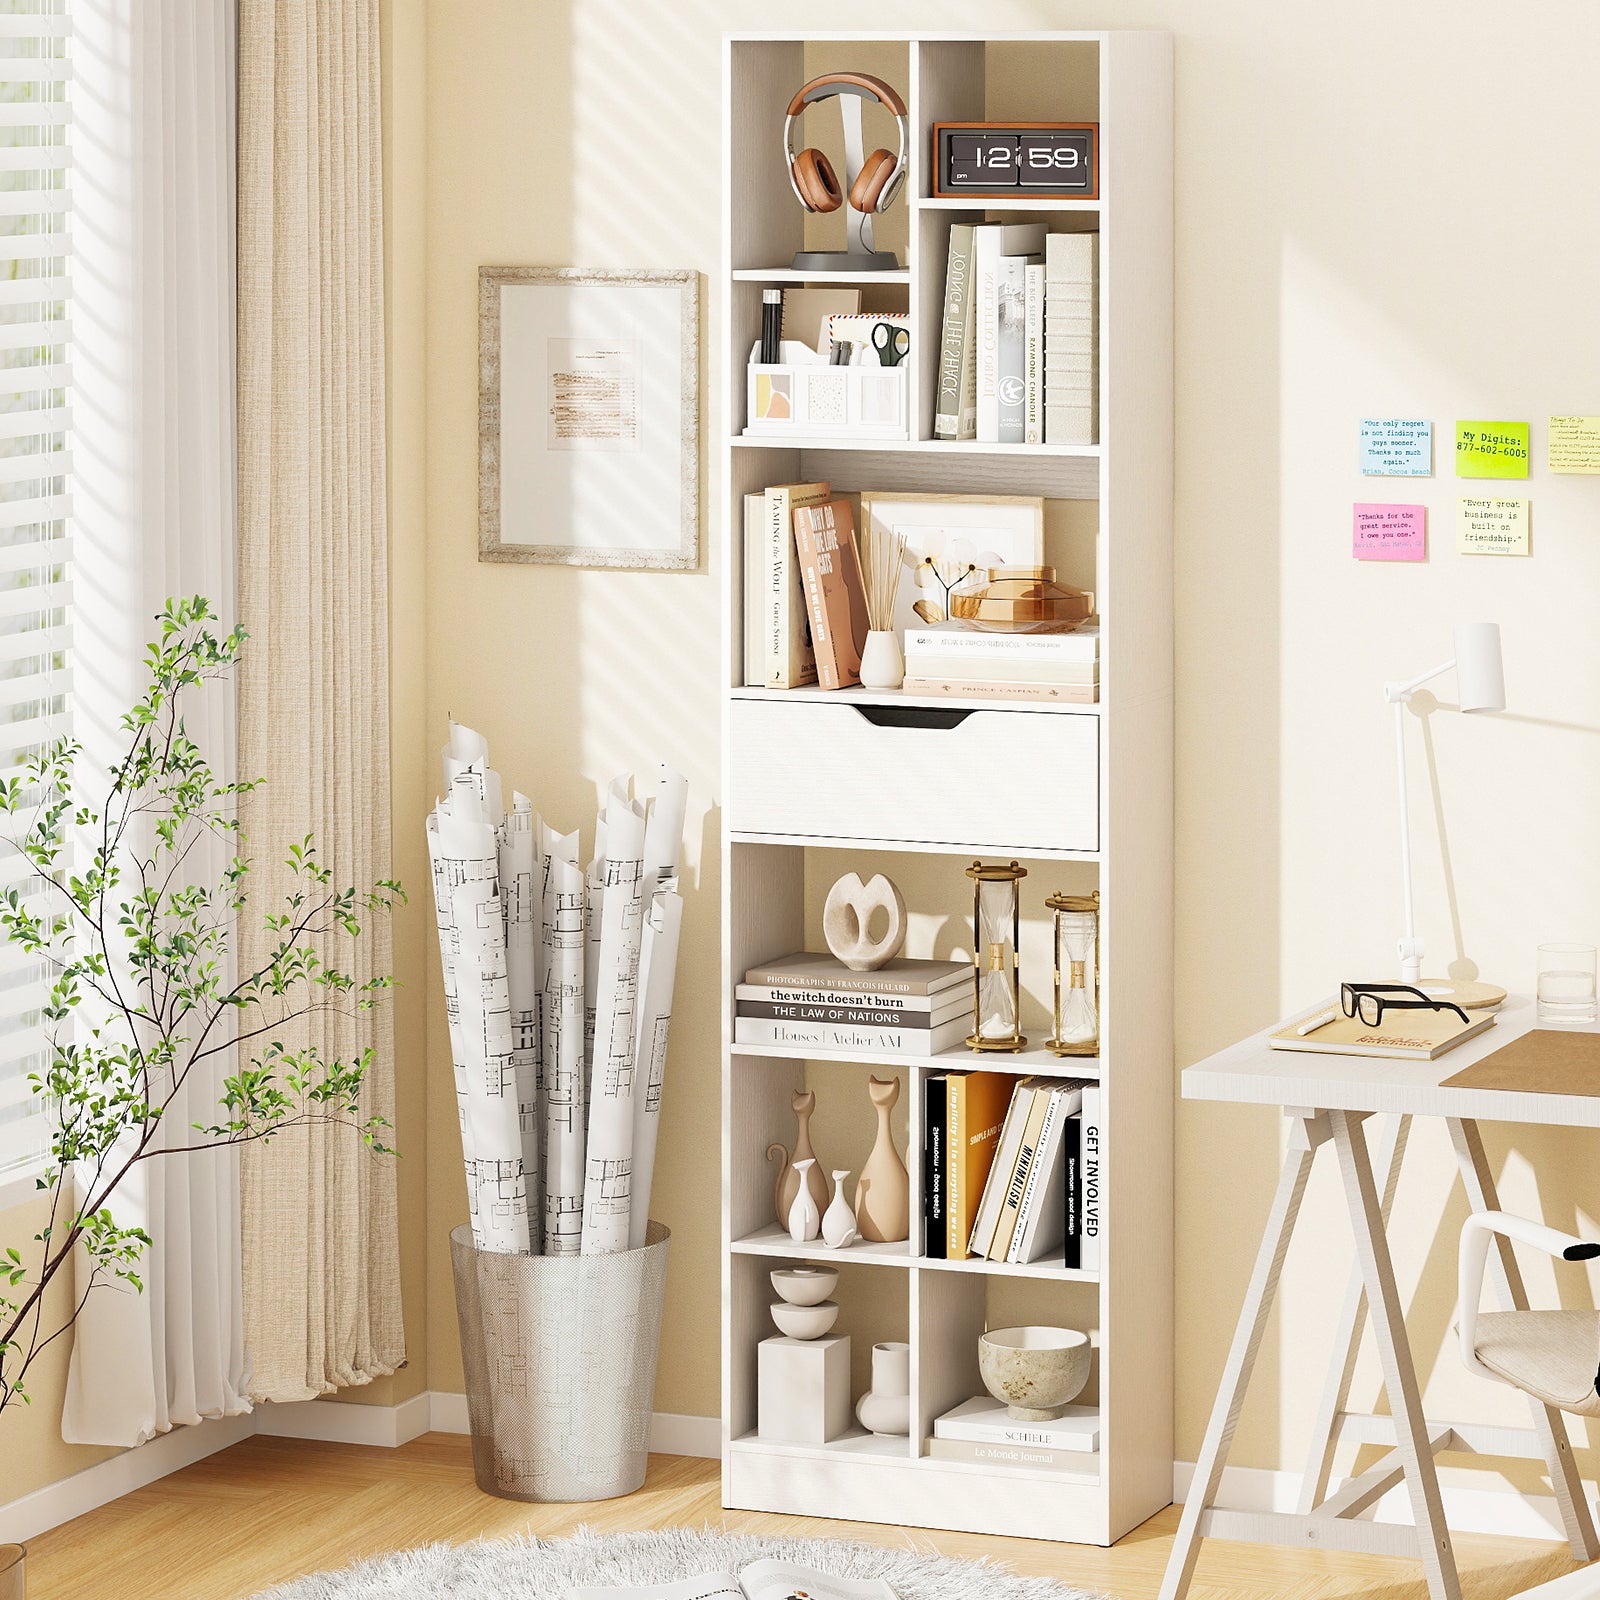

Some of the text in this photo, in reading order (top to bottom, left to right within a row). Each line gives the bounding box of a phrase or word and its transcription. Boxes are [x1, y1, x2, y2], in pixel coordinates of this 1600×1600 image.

[1383, 420, 1399, 428] only
[1402, 420, 1425, 428] regret
[1387, 430, 1414, 438] finding
[1462, 431, 1521, 446] My Digits:
[1456, 442, 1528, 459] 877-602-6005
[1496, 500, 1521, 509] great
[1464, 510, 1518, 520] business is
[1472, 522, 1496, 530] built
[772, 495, 784, 657] TAMING the WOLF GREG STONE
[806, 566, 826, 642] WHY DO WE LOVE CATS
[962, 686, 1040, 696] PRINCE CASPIAN
[766, 975, 826, 986] PHOTOGRAPHS
[838, 980, 877, 991] FRANÇOIS
[878, 983, 910, 992] HALARD
[770, 990, 791, 1001] the
[791, 991, 826, 1004] witch
[874, 996, 904, 1008] burn
[772, 1006, 900, 1024] THE LAW OF NATIONS
[774, 1027, 820, 1043] Houses
[832, 1032, 874, 1047] Atelier
[950, 1086, 959, 1136] simplicity
[1040, 1102, 1056, 1147] simplicity
[950, 1138, 958, 1147] is
[970, 1130, 987, 1146] SIMPLE
[986, 1125, 998, 1138] AND
[950, 1149, 958, 1159] in
[1034, 1160, 1041, 1170] in
[1006, 1144, 1034, 1210] MINIMALISM
[1086, 1126, 1099, 1238] GET INVOLVED
[950, 1162, 958, 1214] everything
[1020, 1172, 1036, 1220] everything
[950, 1216, 958, 1230] we
[1005, 1431, 1052, 1444] SCHIELE
[974, 1448, 1053, 1464] Le Monde Journal
